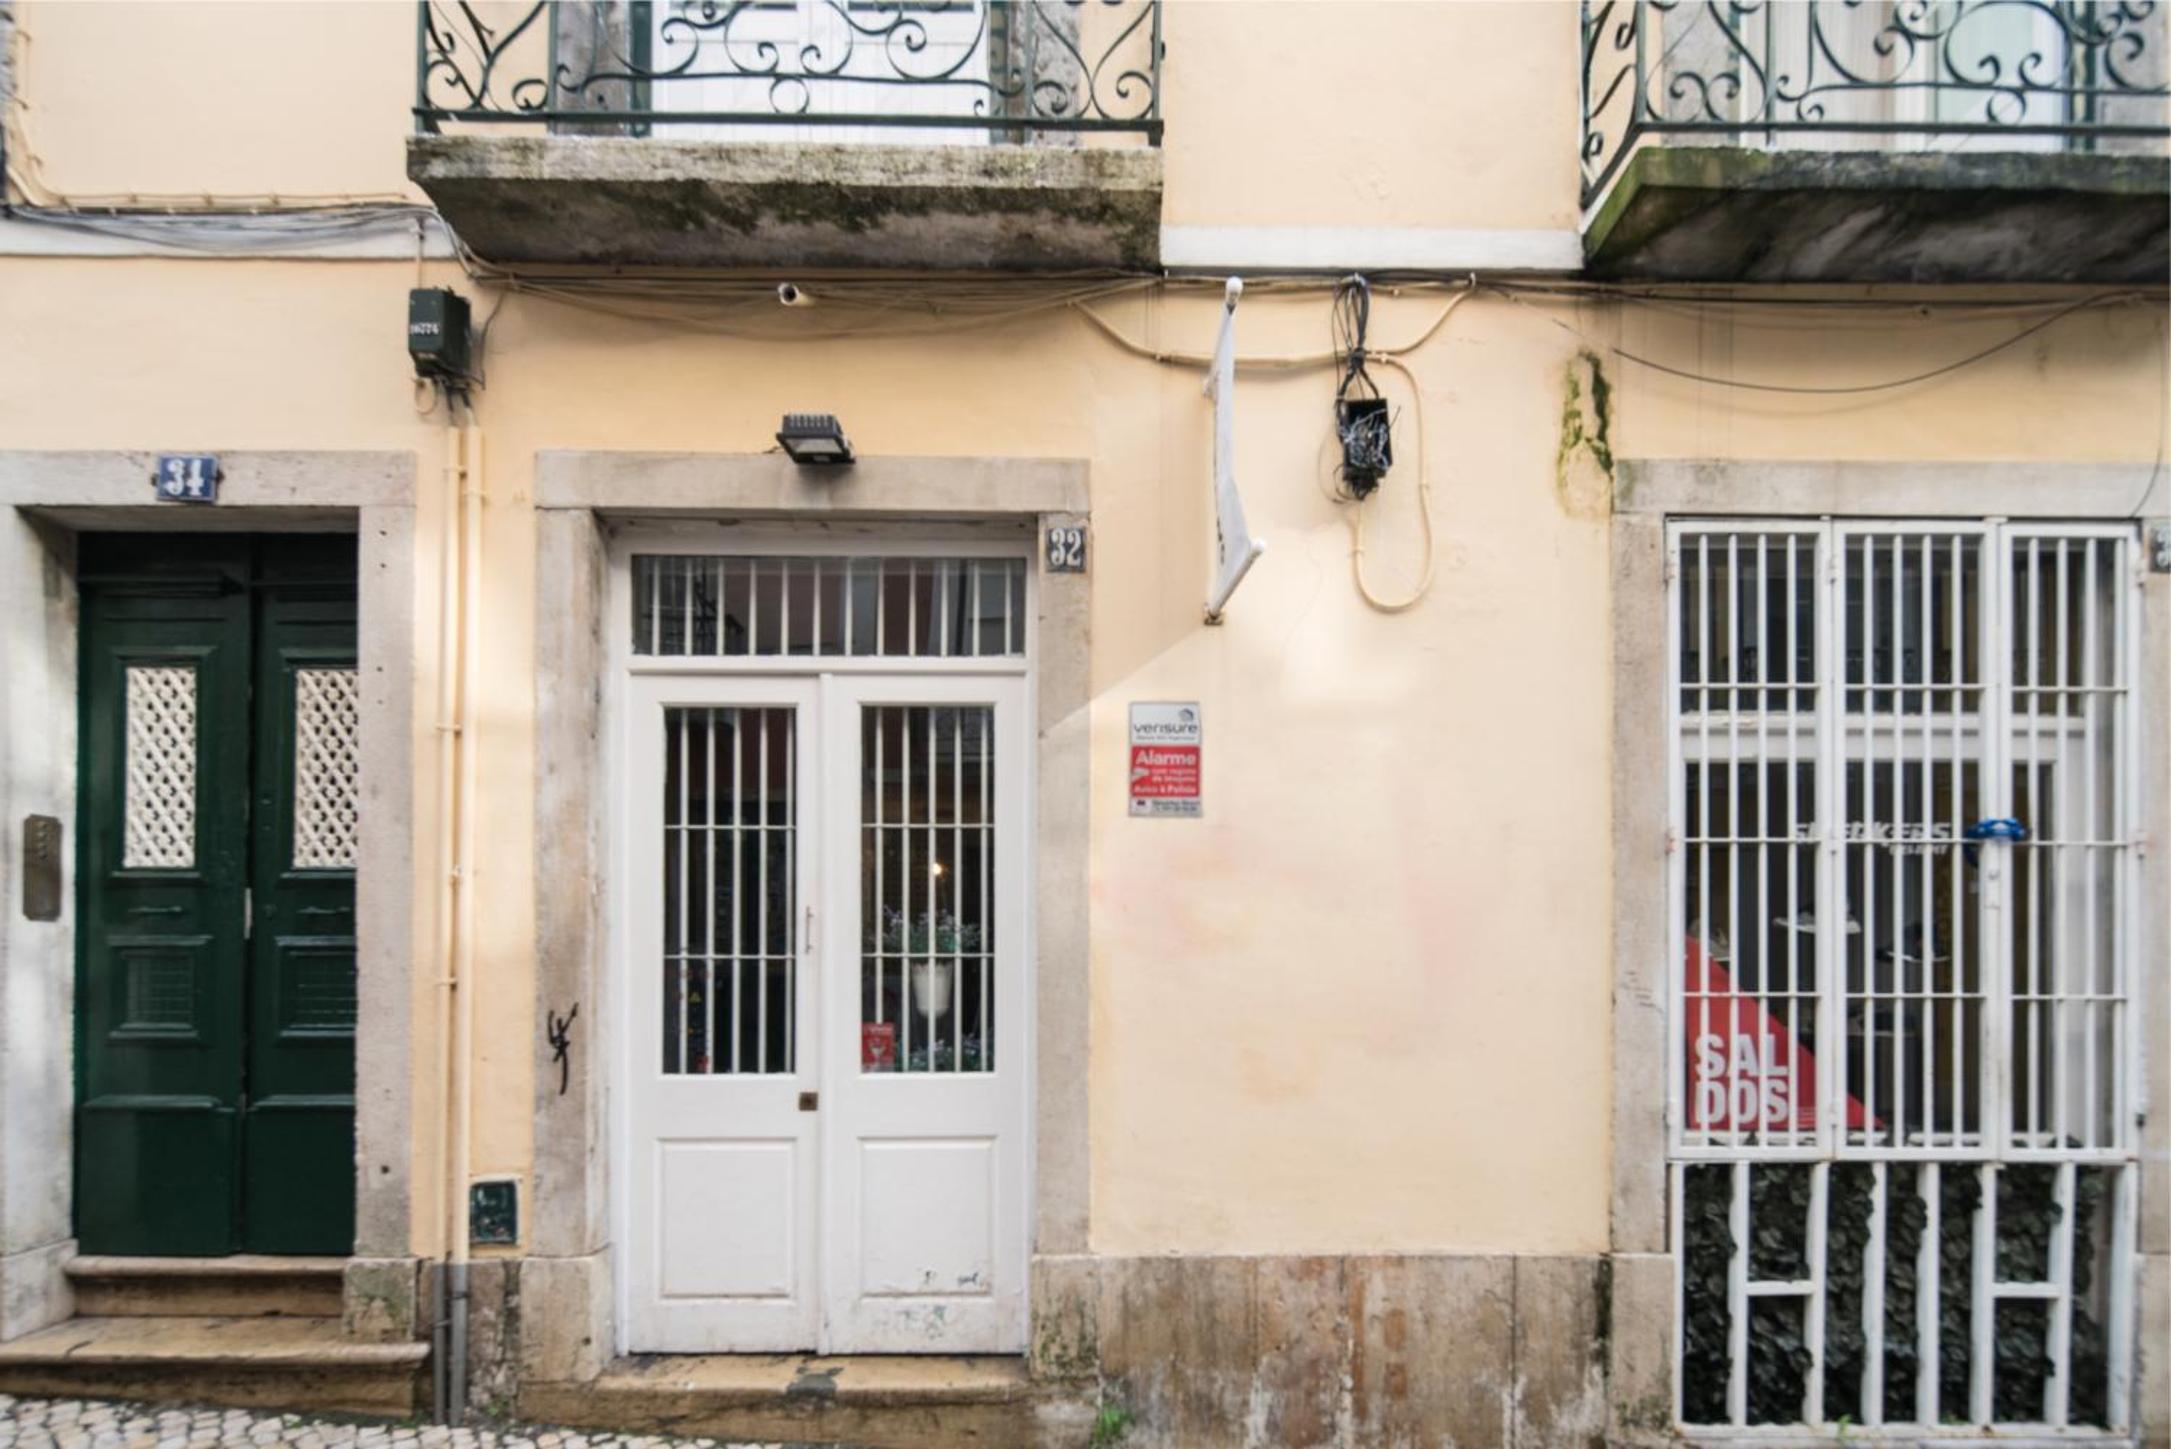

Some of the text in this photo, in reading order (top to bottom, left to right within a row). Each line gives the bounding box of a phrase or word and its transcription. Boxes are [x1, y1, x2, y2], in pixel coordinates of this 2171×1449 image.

[163, 459, 205, 496] 31
[1050, 528, 1081, 567] 32
[1135, 749, 1197, 766] Alarme
[1695, 1033, 1788, 1078] SAL
[1695, 1078, 1788, 1124] DOS
